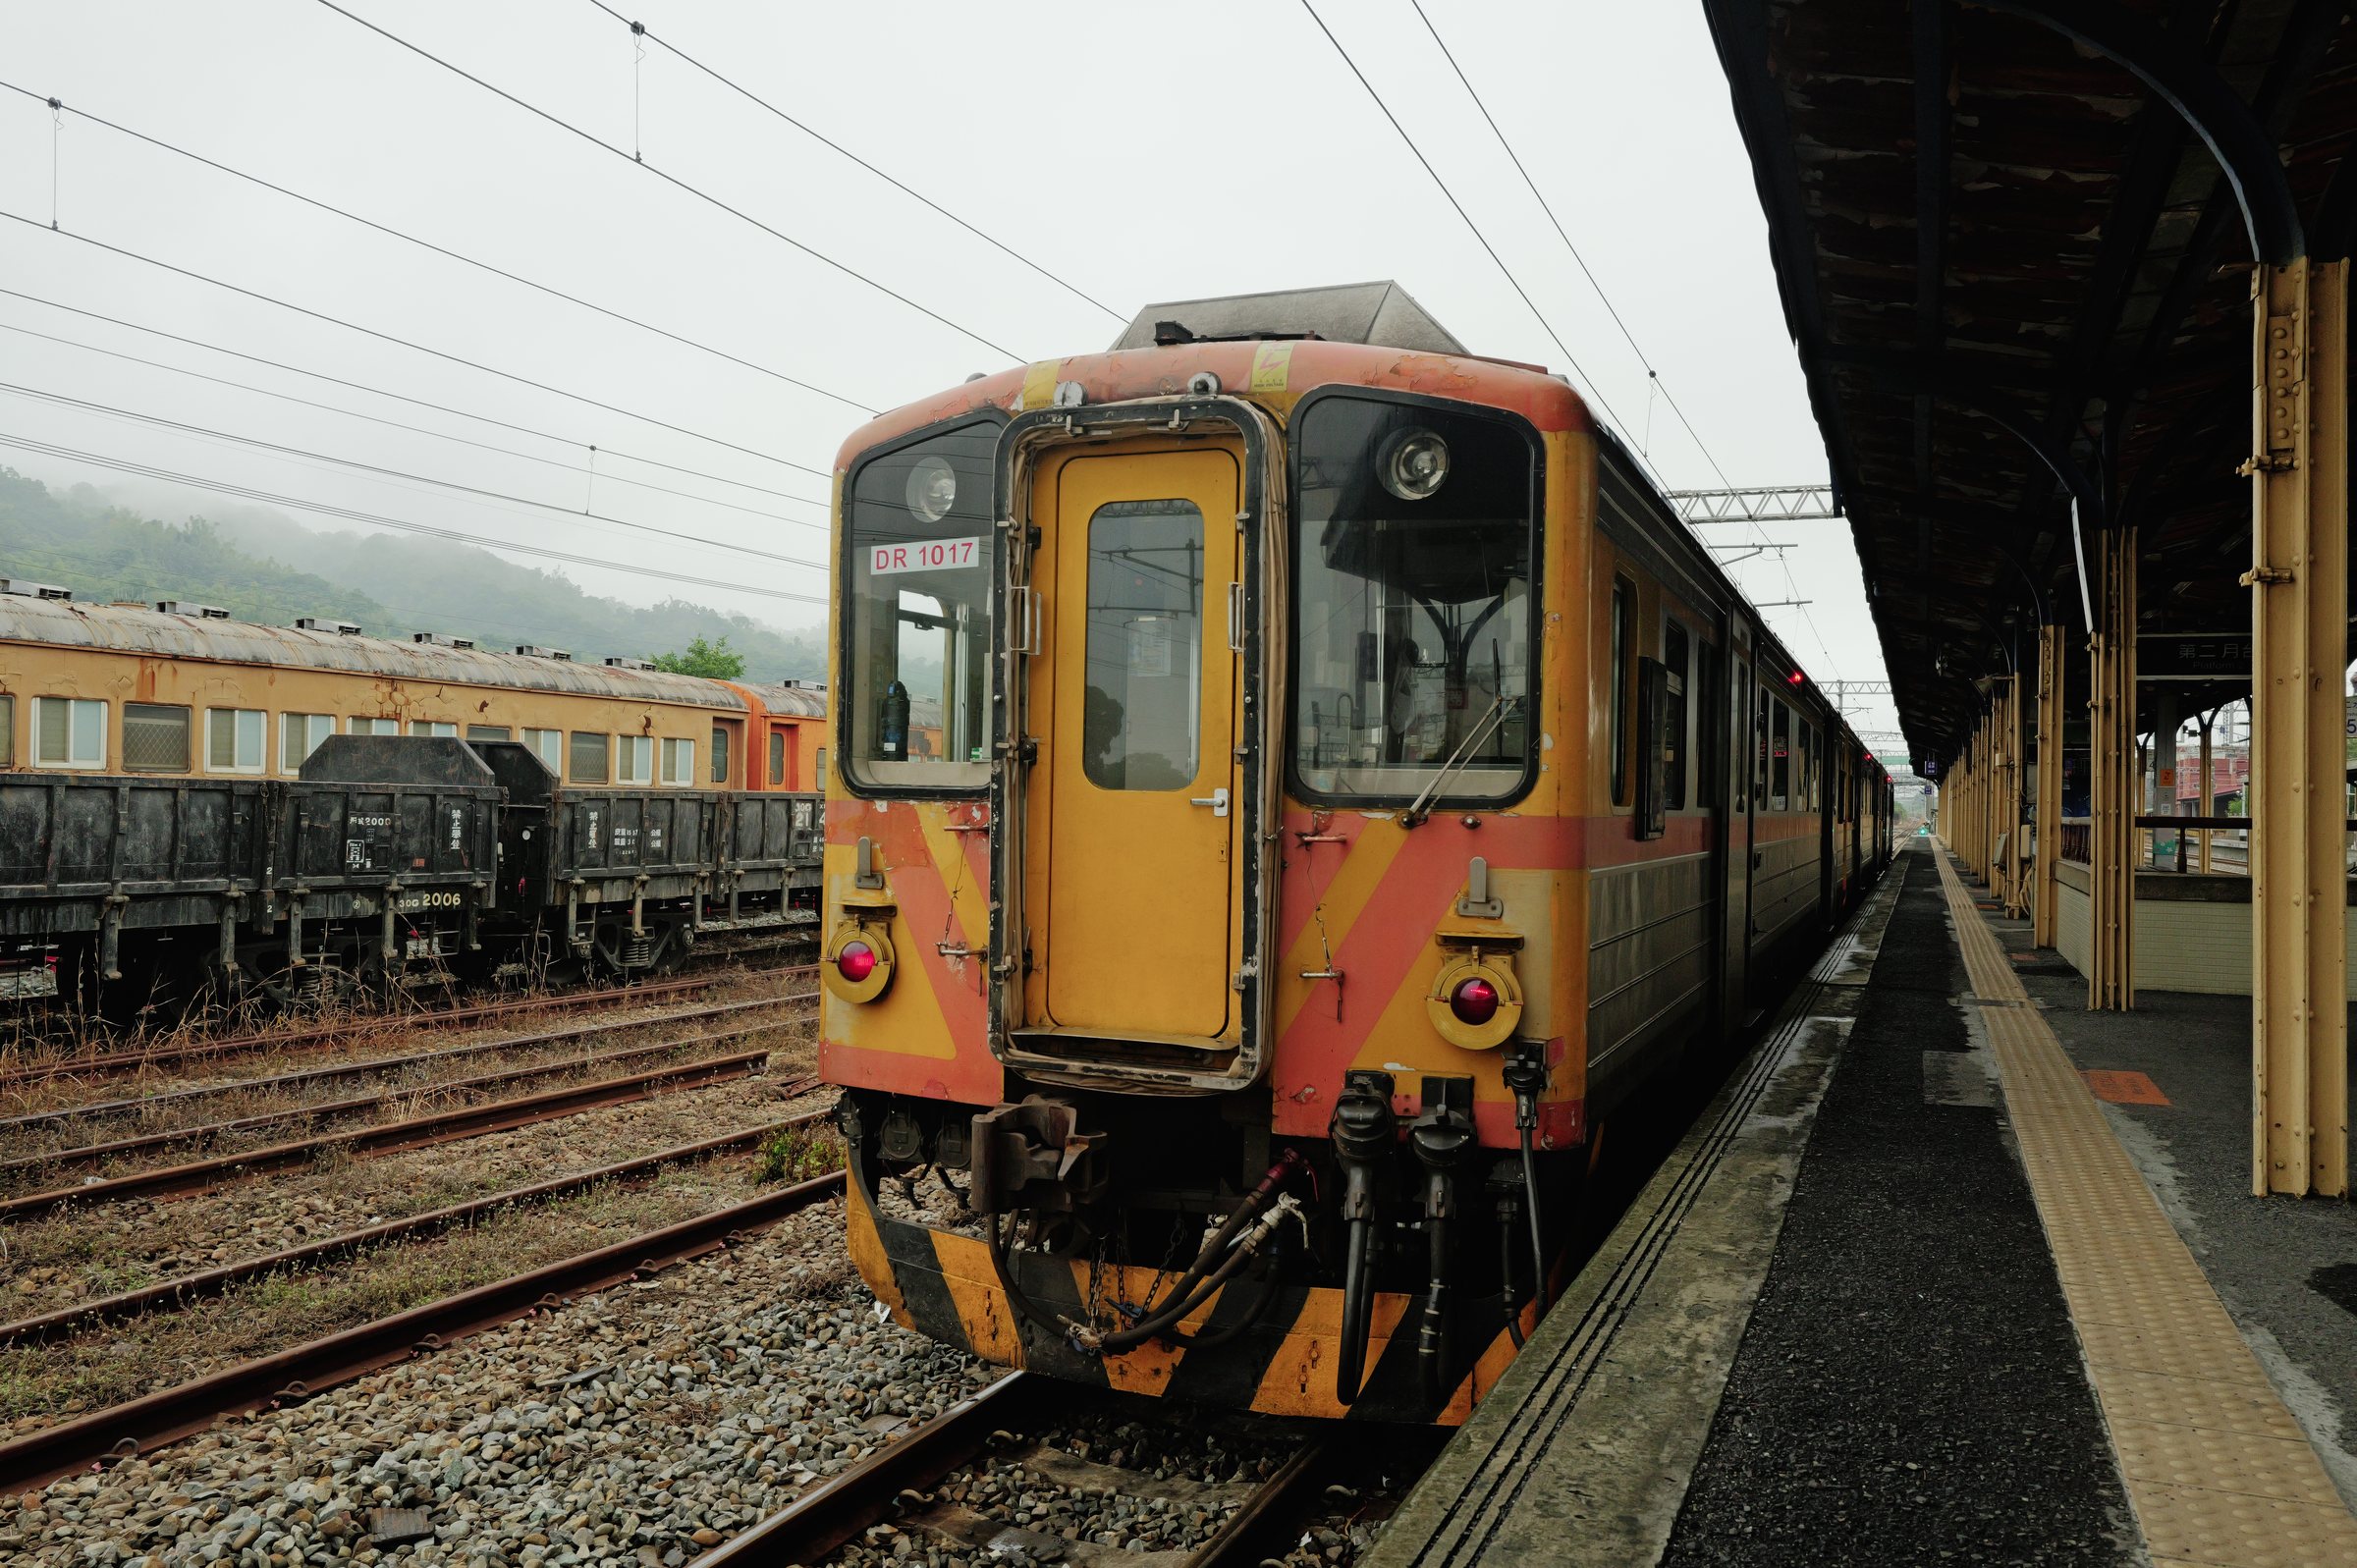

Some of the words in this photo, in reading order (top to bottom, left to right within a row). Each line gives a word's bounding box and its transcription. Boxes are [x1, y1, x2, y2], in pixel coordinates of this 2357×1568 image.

[876, 548, 907, 569] DR
[918, 542, 973, 567] 1017
[422, 892, 463, 907] 2006
